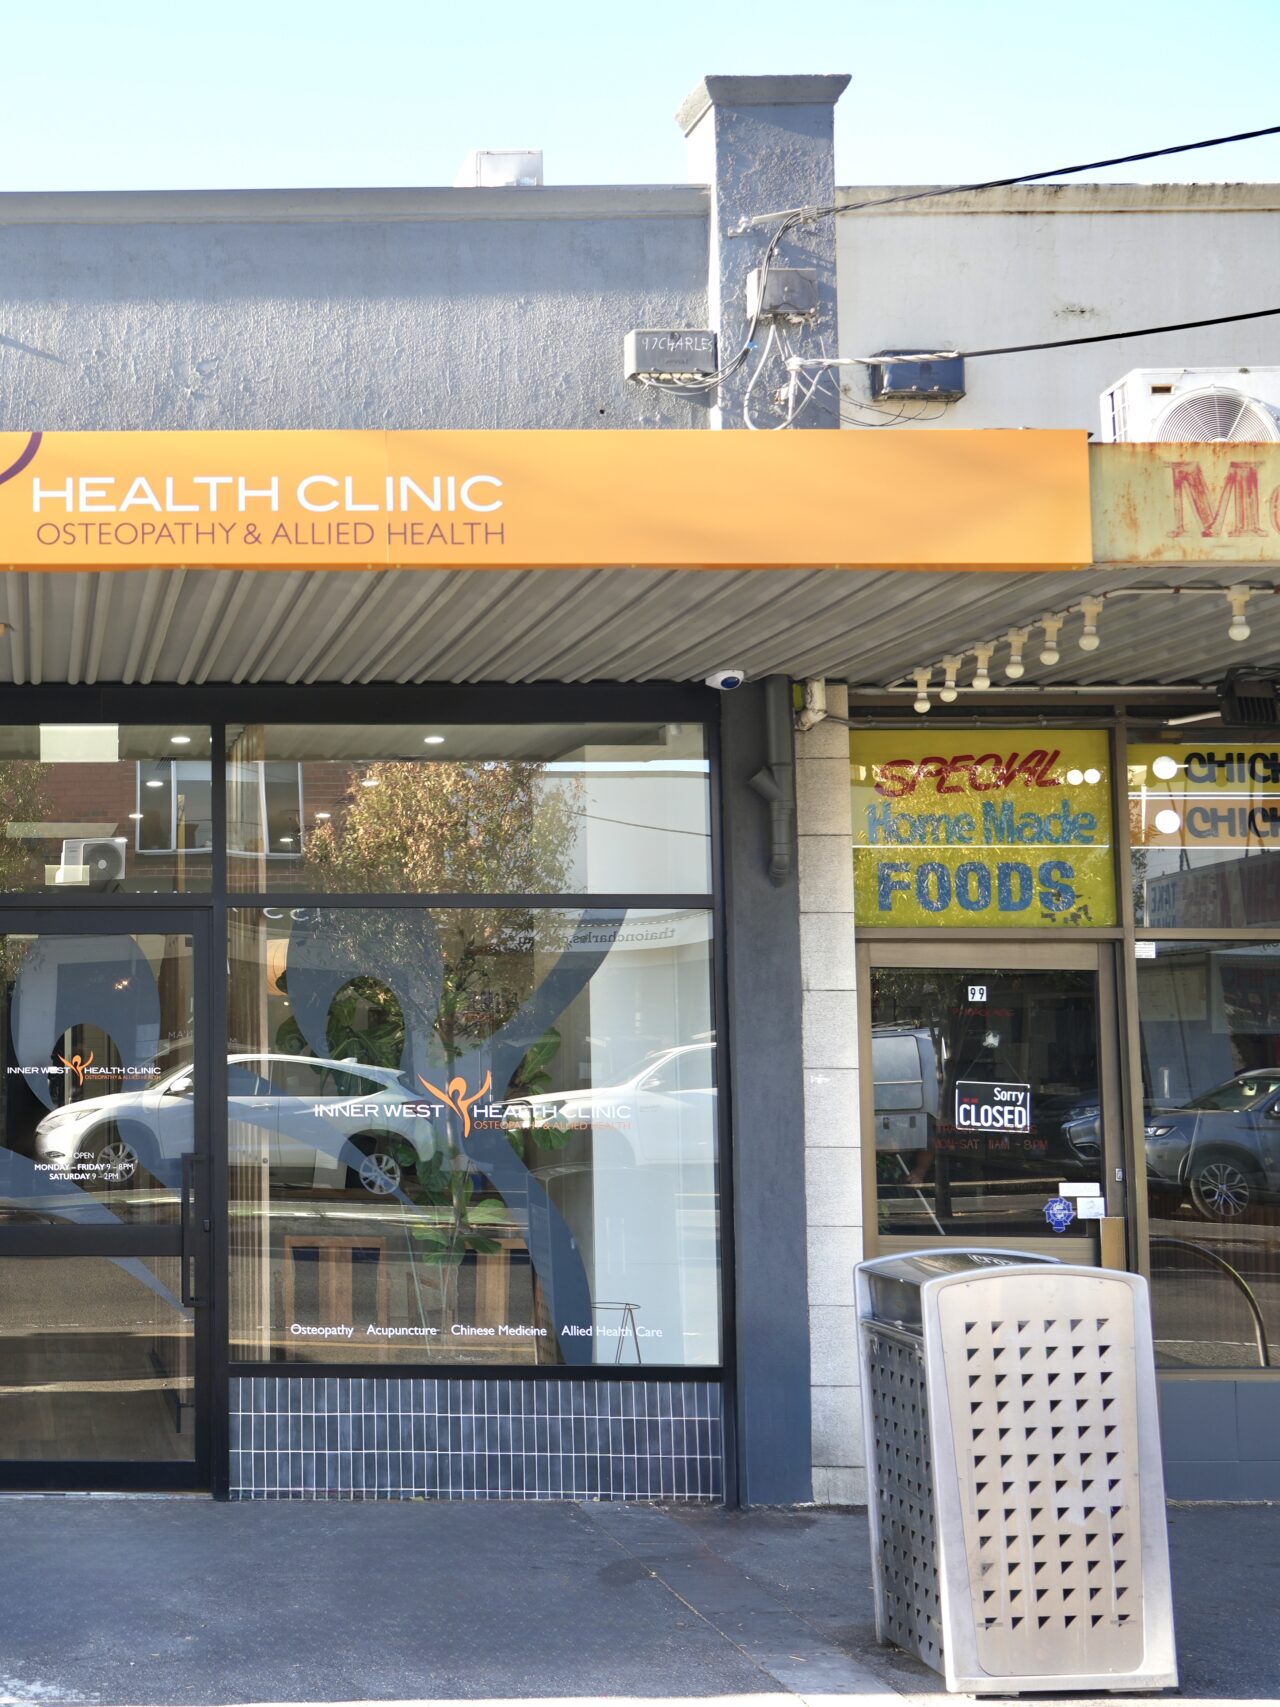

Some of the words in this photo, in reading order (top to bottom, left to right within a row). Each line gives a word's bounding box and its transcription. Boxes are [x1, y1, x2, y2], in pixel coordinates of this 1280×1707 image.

[32, 476, 279, 512] HEALTH
[296, 475, 504, 512] CLINIC
[36, 522, 237, 545] OSTEOPATHY
[243, 522, 262, 545] &
[271, 522, 375, 545] ALLIED
[387, 522, 505, 545] HEALTH
[874, 749, 1062, 798] SPECIAL
[867, 801, 976, 844] Home
[982, 800, 1098, 844] Made
[877, 861, 1077, 913] FOODS
[970, 987, 985, 1000] 99
[993, 1087, 1025, 1105] Sorry
[314, 1104, 379, 1118] INNER
[383, 1104, 444, 1118] WEST
[474, 1104, 556, 1118] HEALTH
[561, 1104, 632, 1118] CLINIC
[959, 1104, 1027, 1129] CLOSED
[290, 1323, 354, 1338] Osteopathy
[366, 1323, 437, 1338] Acupuncture
[450, 1323, 495, 1337] Chinese
[498, 1323, 547, 1337] Medicine
[561, 1323, 593, 1337] Allied
[596, 1324, 632, 1337] Health
[636, 1324, 663, 1338] Care
